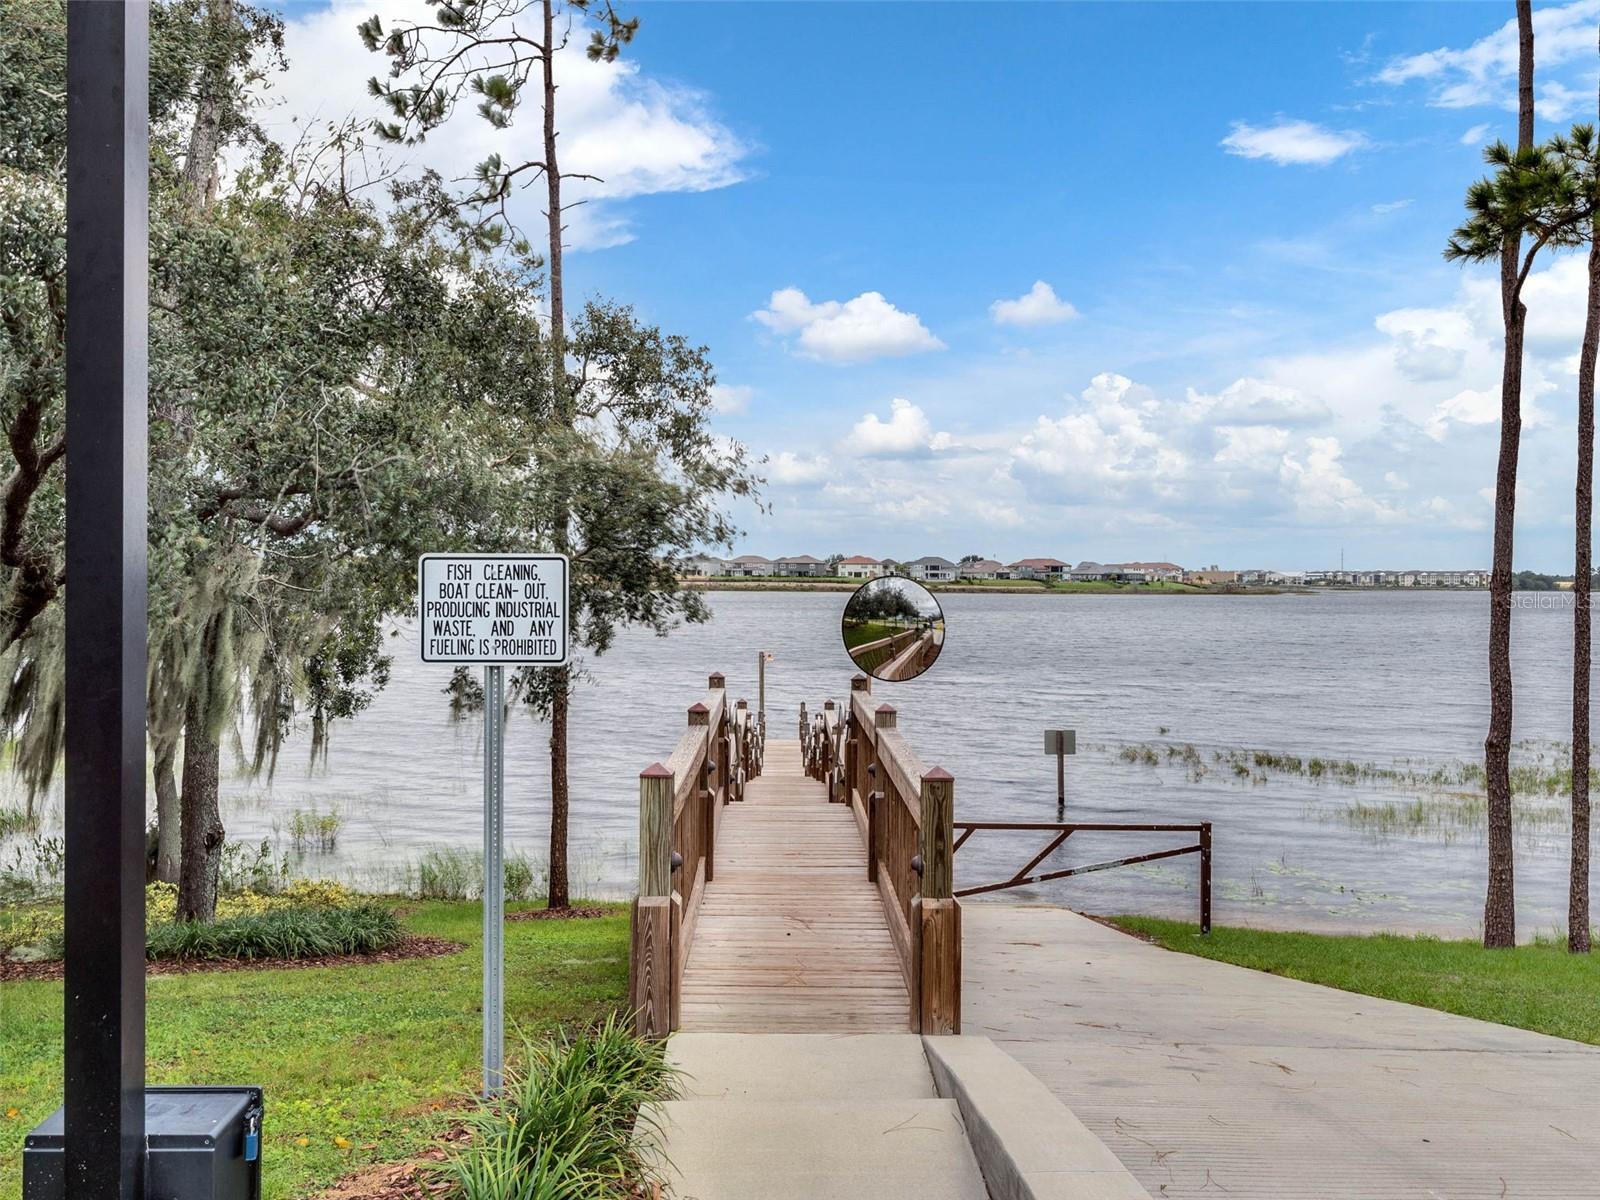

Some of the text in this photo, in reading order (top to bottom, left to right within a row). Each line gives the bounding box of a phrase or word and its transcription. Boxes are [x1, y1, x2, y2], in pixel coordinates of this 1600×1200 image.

[447, 564, 472, 580] FISH
[439, 583, 469, 599] BOAT
[427, 602, 560, 618] PRODUCING INDUSTRIAL
[491, 621, 514, 636] AND
[530, 621, 554, 636] ANY
[430, 639, 556, 655] FUELING IS PROHIBITED
